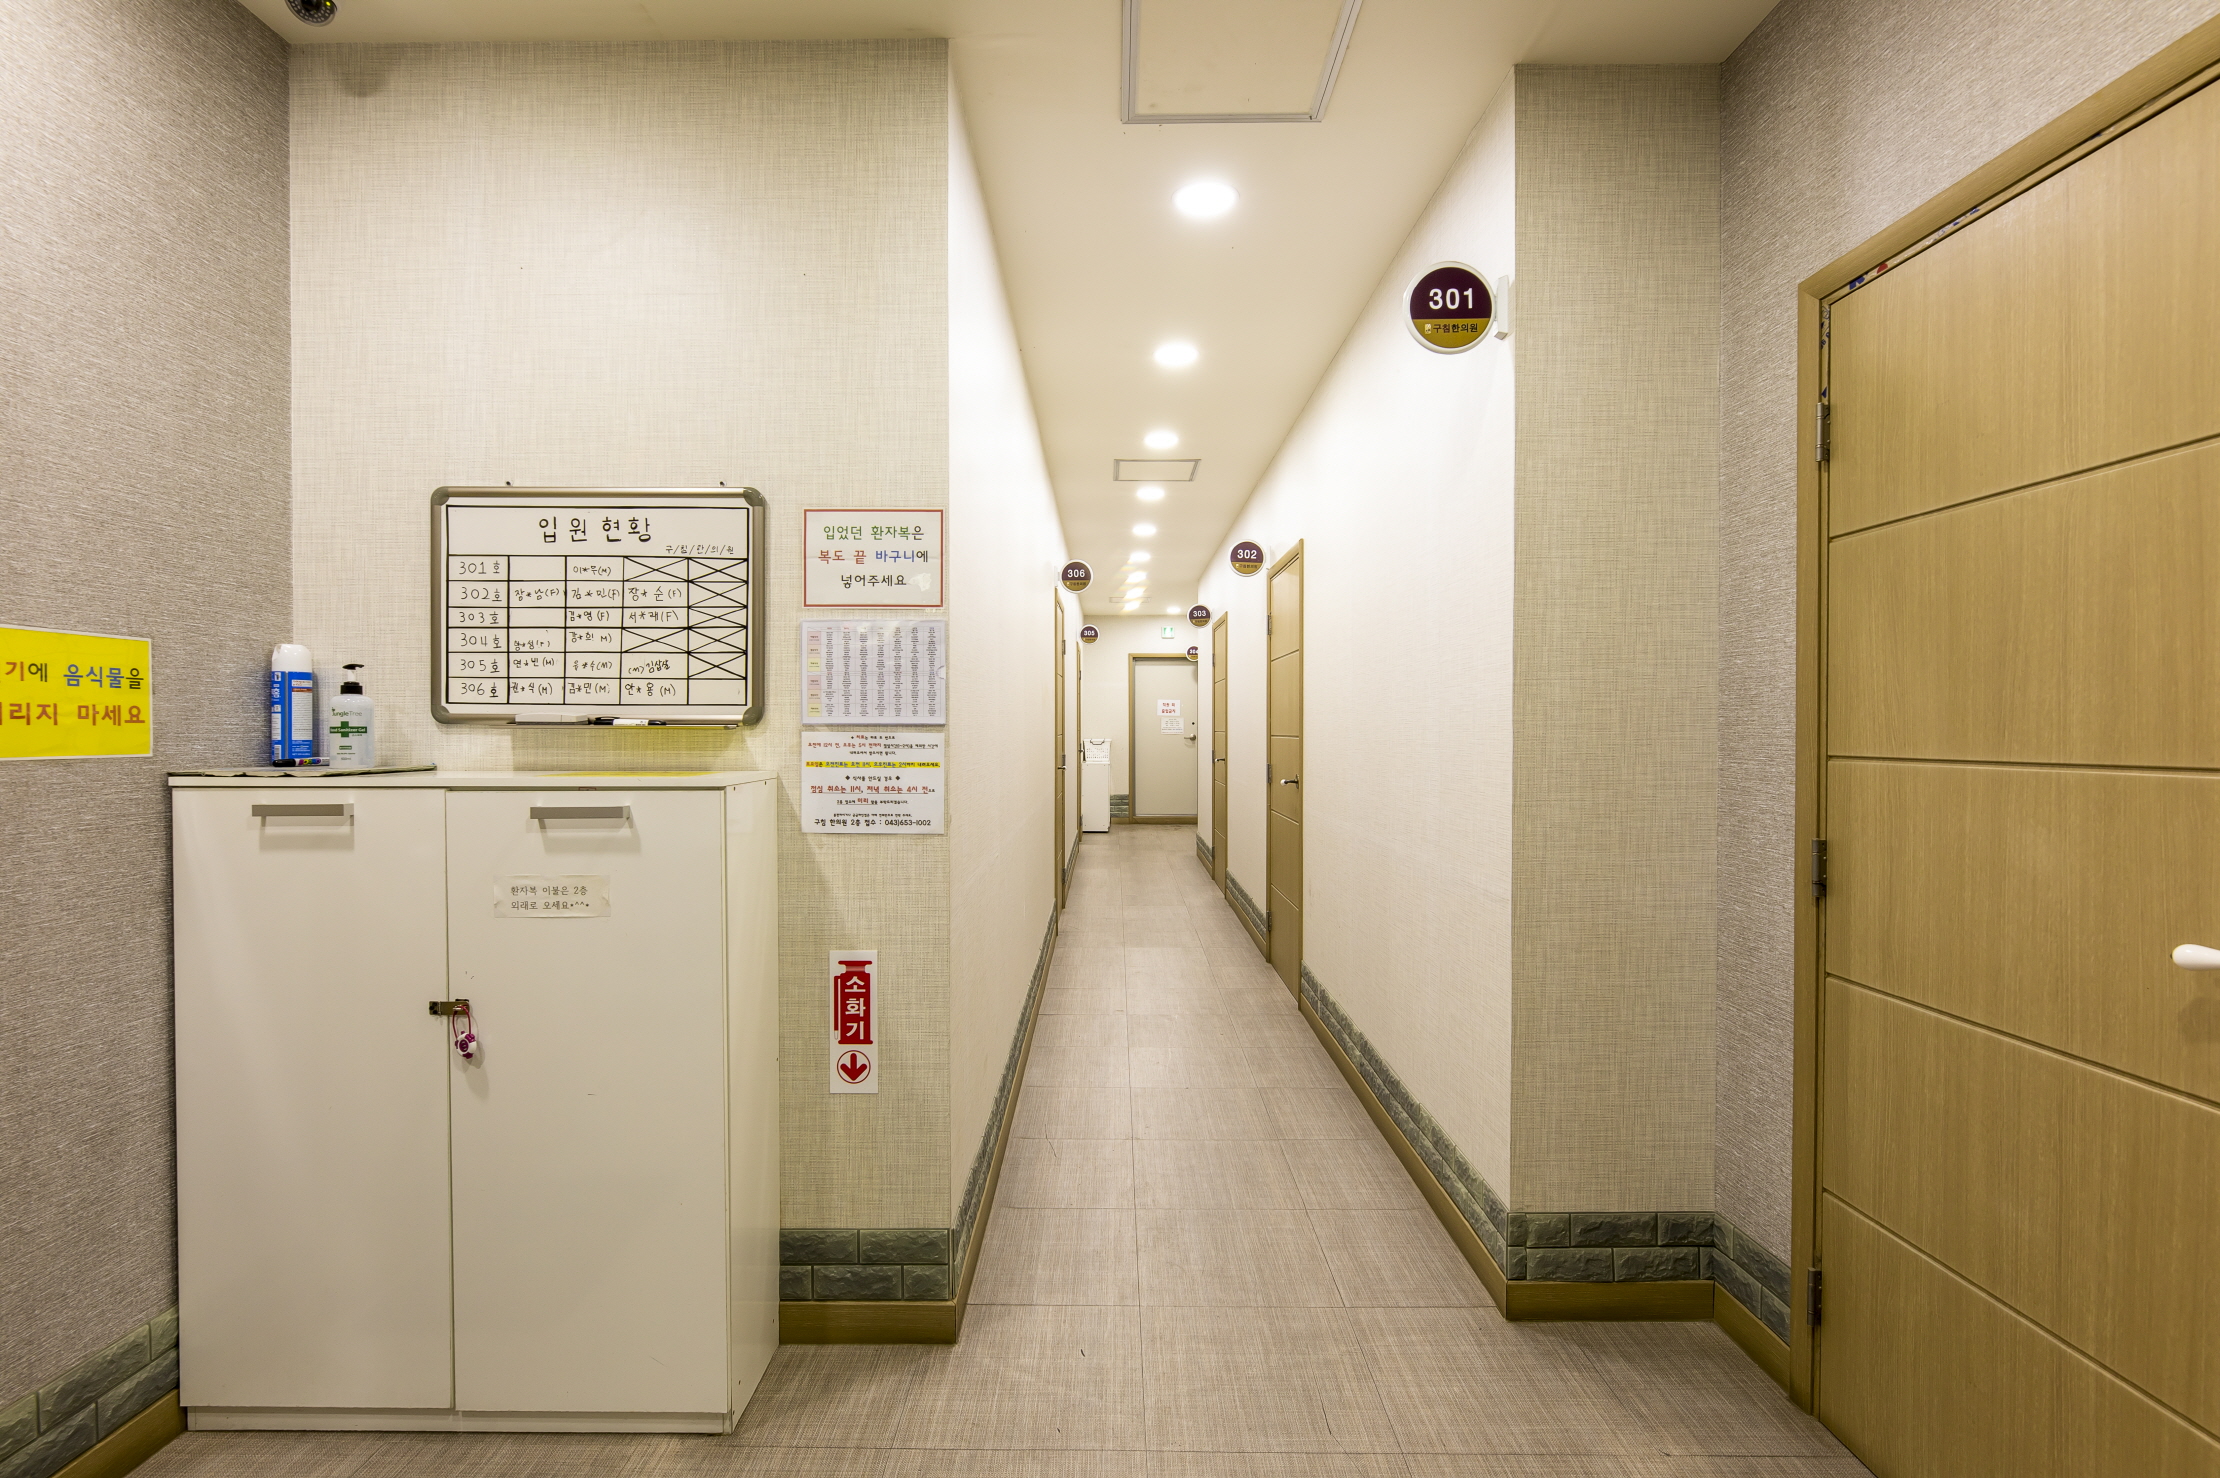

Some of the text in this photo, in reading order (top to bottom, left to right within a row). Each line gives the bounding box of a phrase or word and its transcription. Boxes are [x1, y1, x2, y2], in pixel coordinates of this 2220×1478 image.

[1428, 287, 1473, 310] 301
[1433, 323, 1478, 334] 구침한의원
[823, 525, 924, 541] 입었던 환자복은
[818, 549, 928, 565] 복도 끝 바구니에
[1236, 549, 1257, 559] 302
[1067, 569, 1086, 578] 306
[841, 574, 907, 589] 넣어주세요
[1192, 610, 1207, 618] 303
[63, 664, 145, 690] 음식물을
[0, 702, 146, 727] 리지 마세요
[810, 785, 823, 794] 점심
[827, 785, 847, 794] 취소는
[866, 785, 880, 794] 저녁
[883, 785, 904, 794] 취소는
[906, 785, 918, 793] 4시
[814, 818, 827, 827] 구침
[829, 818, 848, 827] 한의원
[850, 818, 861, 827] 2층
[864, 818, 877, 827] 접수
[510, 885, 588, 896] 환자복 이불은 2층
[510, 900, 539, 911] 외래로
[844, 975, 867, 1040] 소화기
